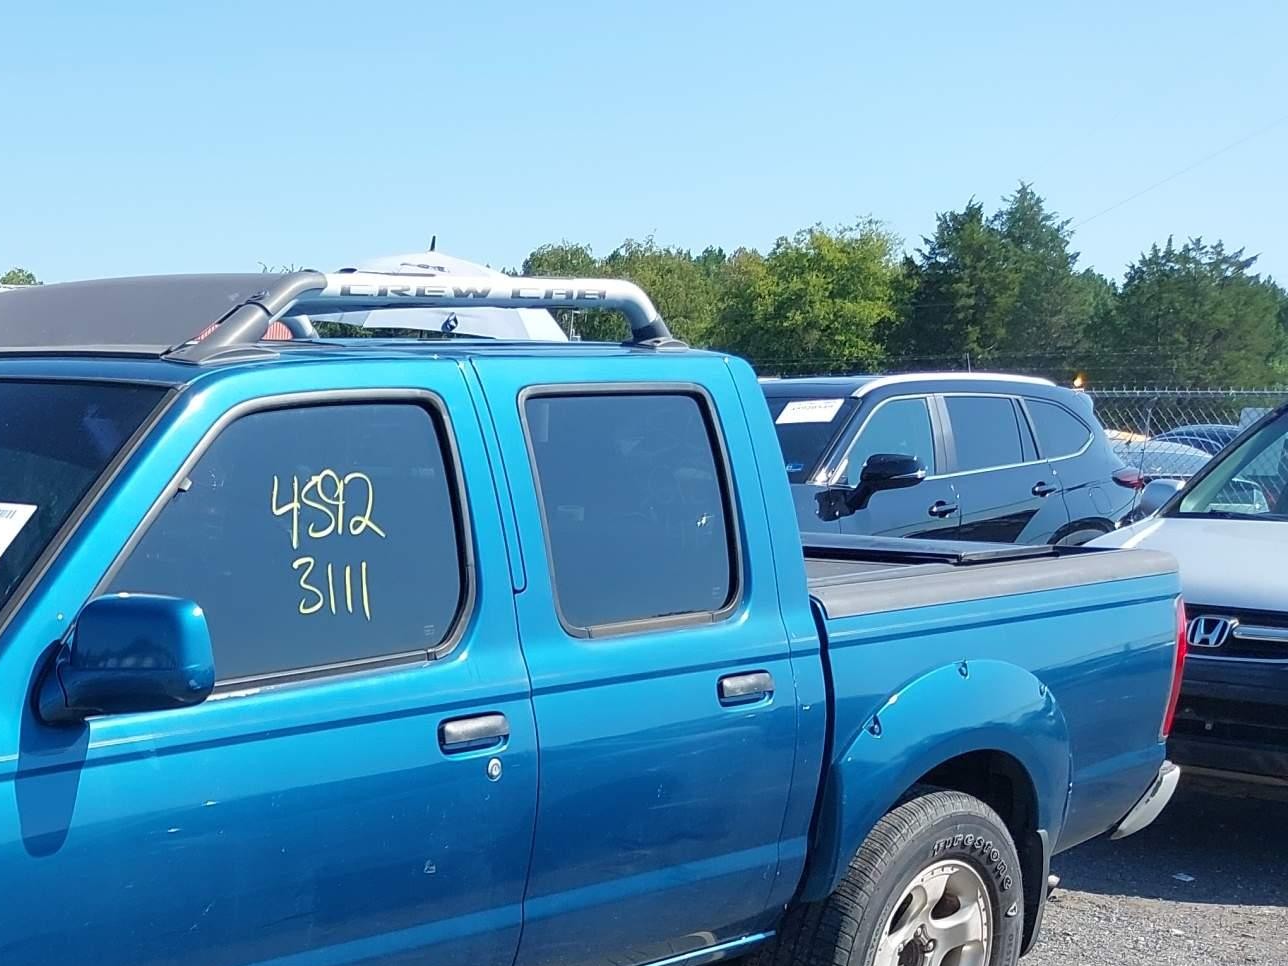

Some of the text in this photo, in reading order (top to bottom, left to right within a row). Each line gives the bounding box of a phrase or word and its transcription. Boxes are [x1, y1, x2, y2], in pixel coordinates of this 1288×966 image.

[339, 284, 607, 300] CREW CAB
[272, 468, 387, 550] 4592
[292, 556, 372, 621] 3111
[933, 834, 1012, 890] Firestone
